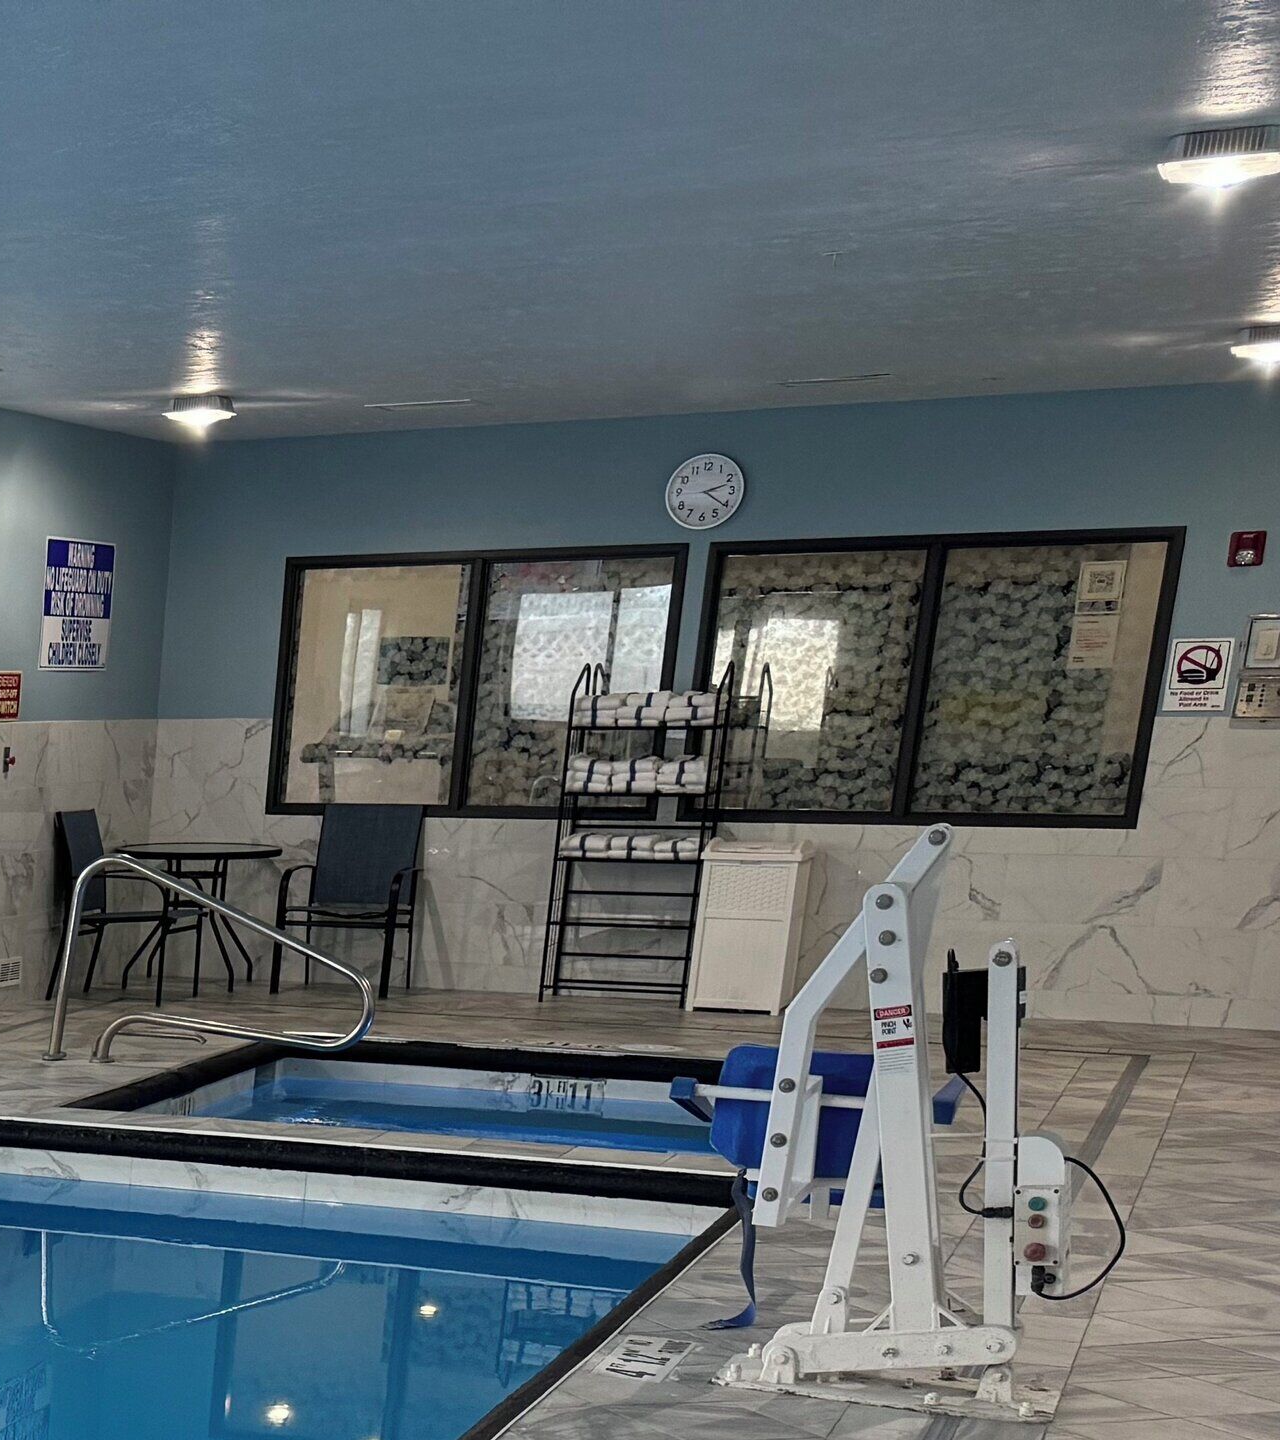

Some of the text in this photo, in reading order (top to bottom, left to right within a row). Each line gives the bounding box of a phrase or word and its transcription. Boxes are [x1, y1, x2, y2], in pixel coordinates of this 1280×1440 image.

[692, 466, 699, 475] 11
[704, 462, 713, 471] 12
[719, 465, 723, 473] 1
[726, 474, 733, 482] 2
[676, 488, 682, 497] 9
[729, 486, 735, 495] 3
[678, 501, 684, 510] 8
[687, 509, 694, 518] 7
[699, 512, 705, 521] 6
[712, 509, 719, 518] 5
[46, 566, 112, 594] NO LIFEGUARD ON DUTY
[66, 592, 74, 616] OF
[48, 642, 77, 665] CHILDREN
[879, 1007, 906, 1018] DANGER
